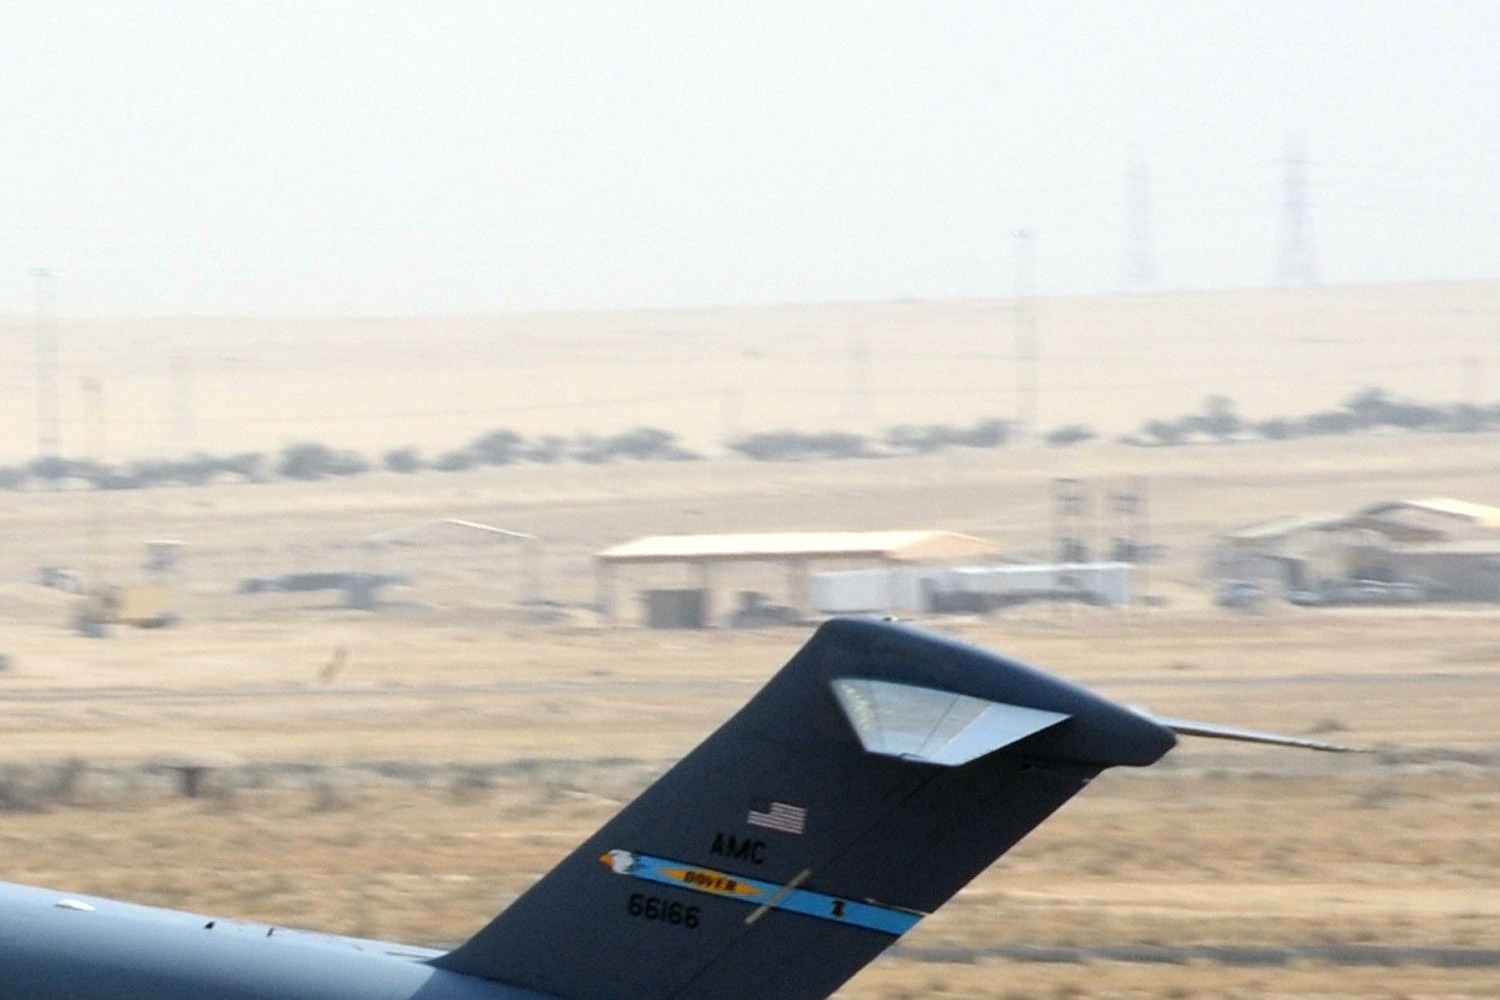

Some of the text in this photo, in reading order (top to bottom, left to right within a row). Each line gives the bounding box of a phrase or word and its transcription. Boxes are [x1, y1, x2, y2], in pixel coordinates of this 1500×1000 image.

[711, 833, 766, 864] AMC
[683, 871, 737, 891] DOVER
[628, 893, 700, 928] 66166
